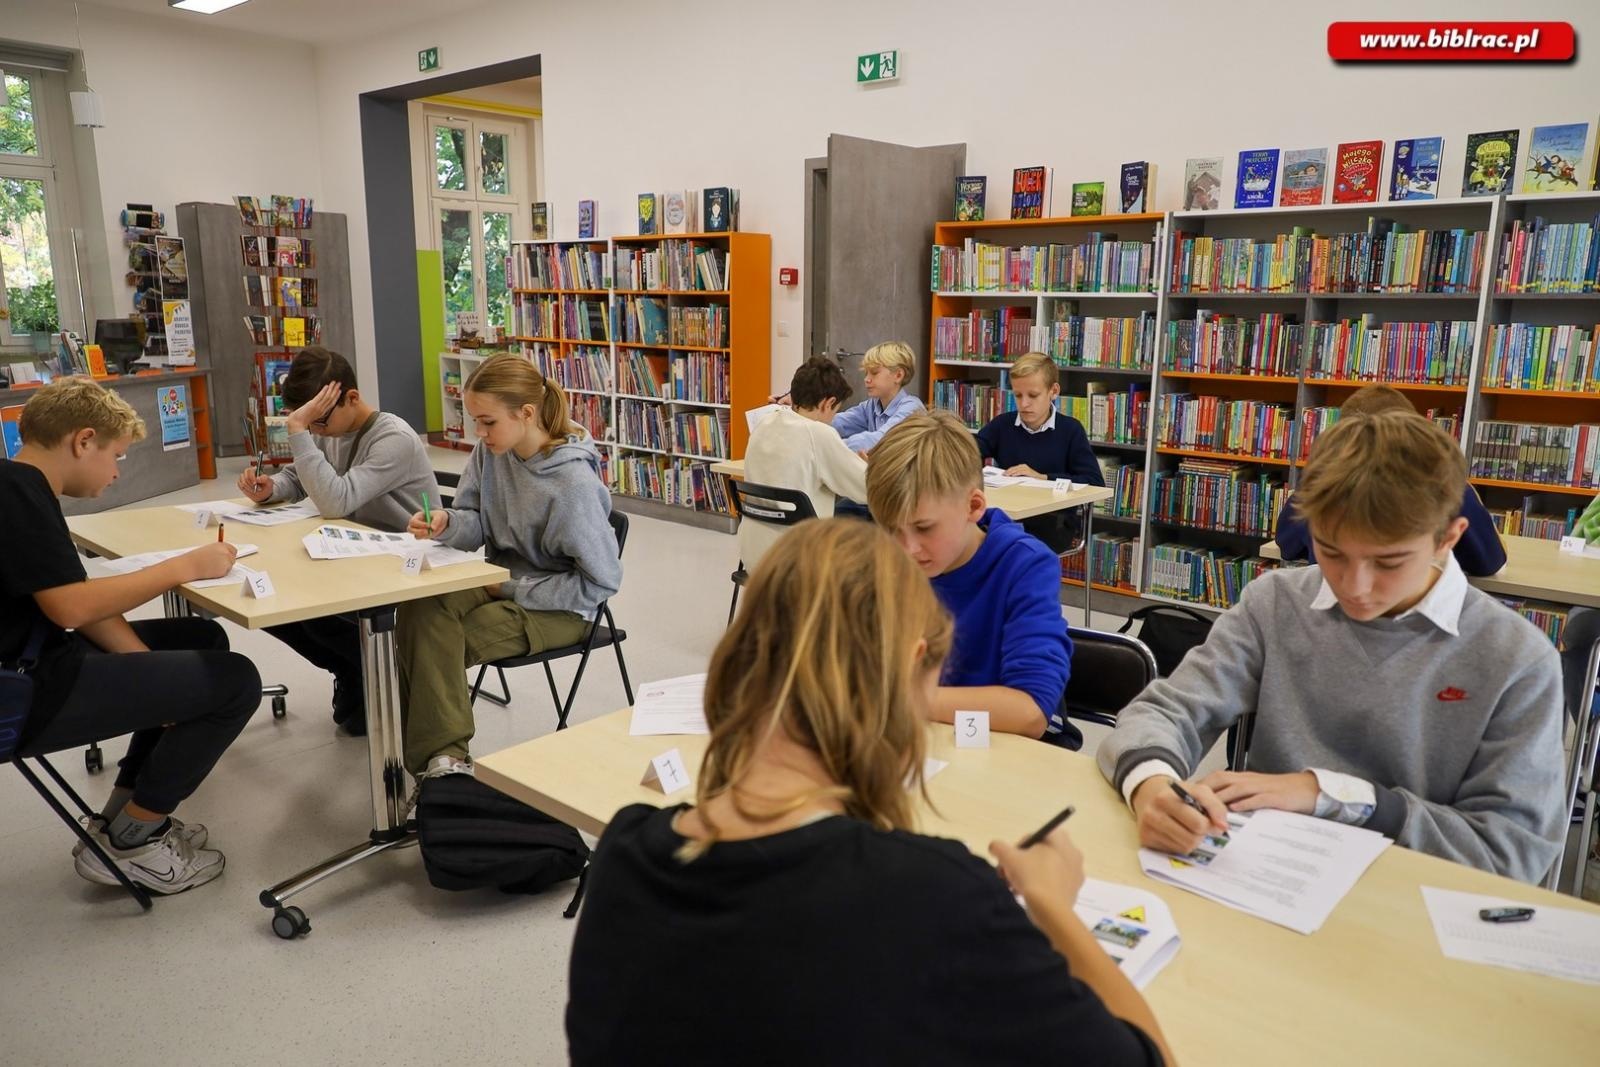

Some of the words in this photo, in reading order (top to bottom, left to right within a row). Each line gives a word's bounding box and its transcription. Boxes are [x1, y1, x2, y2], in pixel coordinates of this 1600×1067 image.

[406, 557, 417, 569] 15
[255, 578, 266, 594] 5
[965, 717, 978, 738] 3
[662, 759, 679, 783] 7
